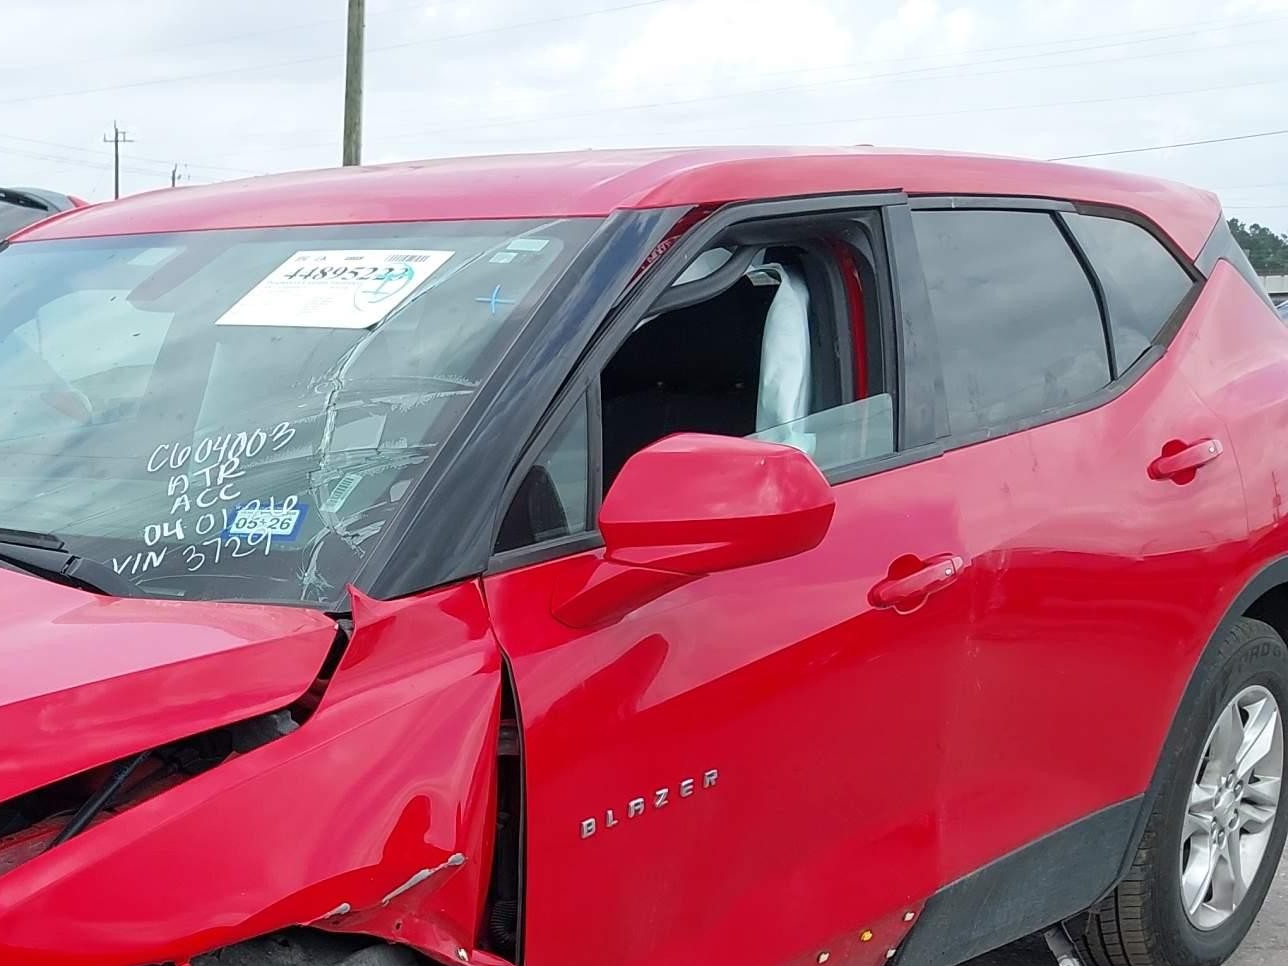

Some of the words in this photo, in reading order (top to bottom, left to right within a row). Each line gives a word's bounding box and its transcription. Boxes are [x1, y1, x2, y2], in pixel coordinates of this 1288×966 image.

[170, 483, 241, 515] ACC
[195, 508, 228, 535] 01
[112, 546, 168, 575] VIN
[580, 768, 719, 839] BLAZER
